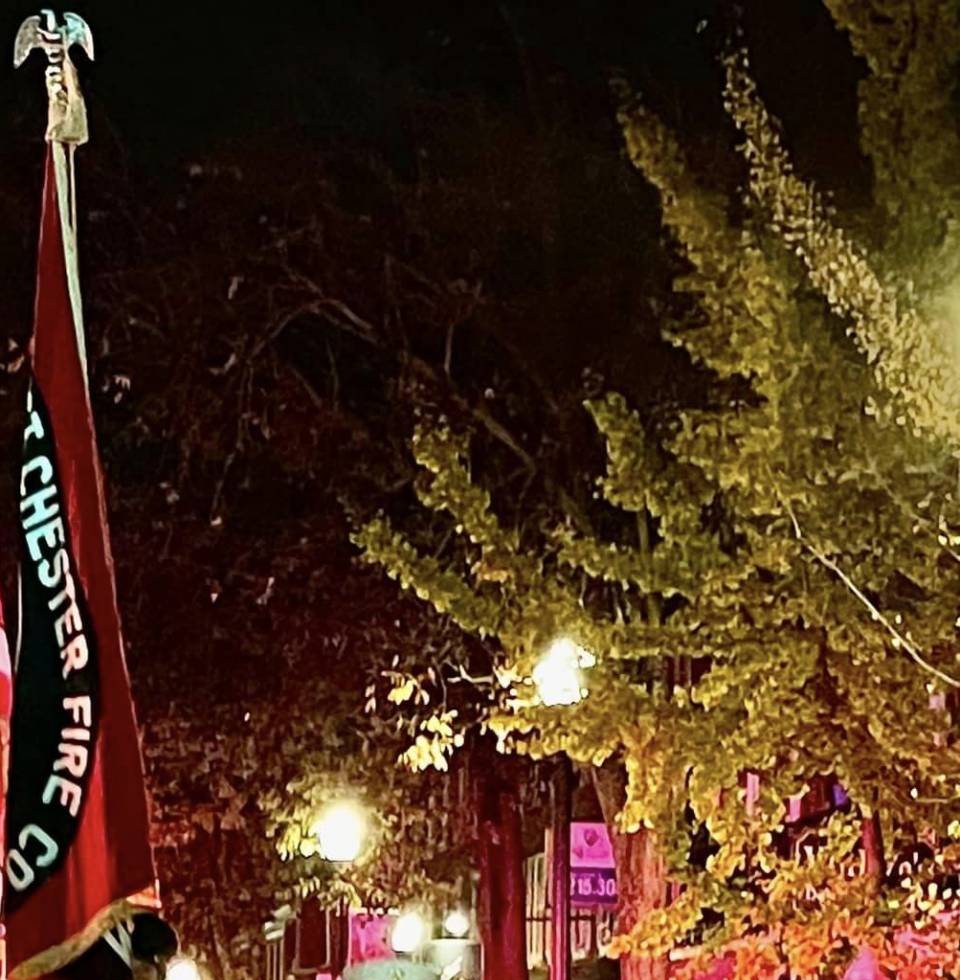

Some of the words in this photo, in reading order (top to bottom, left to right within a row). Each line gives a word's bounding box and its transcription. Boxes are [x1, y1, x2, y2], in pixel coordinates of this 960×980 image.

[20, 455, 89, 681] CHESTER
[42, 695, 92, 818] FIRE
[6, 823, 59, 892] CO
